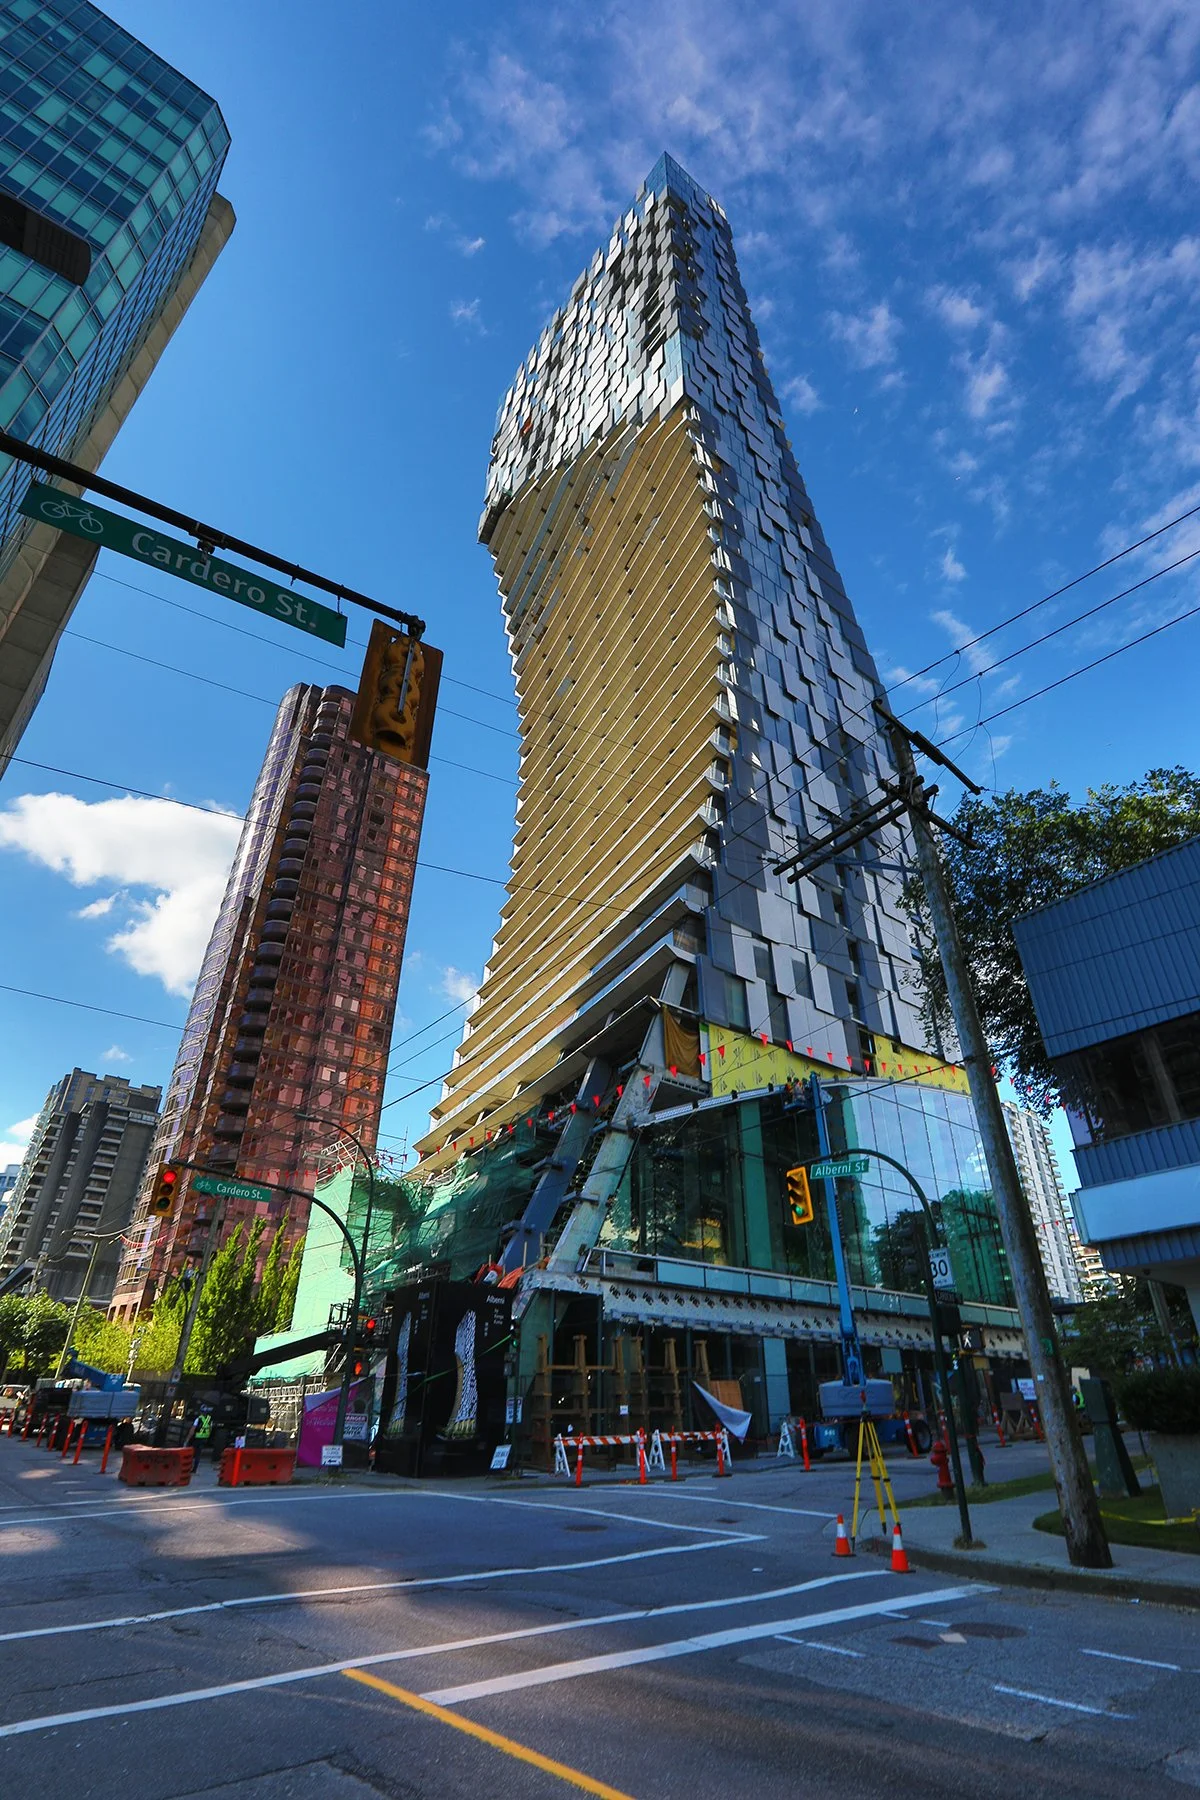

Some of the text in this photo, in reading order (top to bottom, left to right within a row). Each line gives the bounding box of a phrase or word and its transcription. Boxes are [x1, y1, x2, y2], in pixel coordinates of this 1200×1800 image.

[132, 533, 316, 628] Cardero St.
[815, 1161, 866, 1178] Alberni St
[216, 1183, 263, 1200] Cardero St.
[929, 1259, 948, 1278] 30
